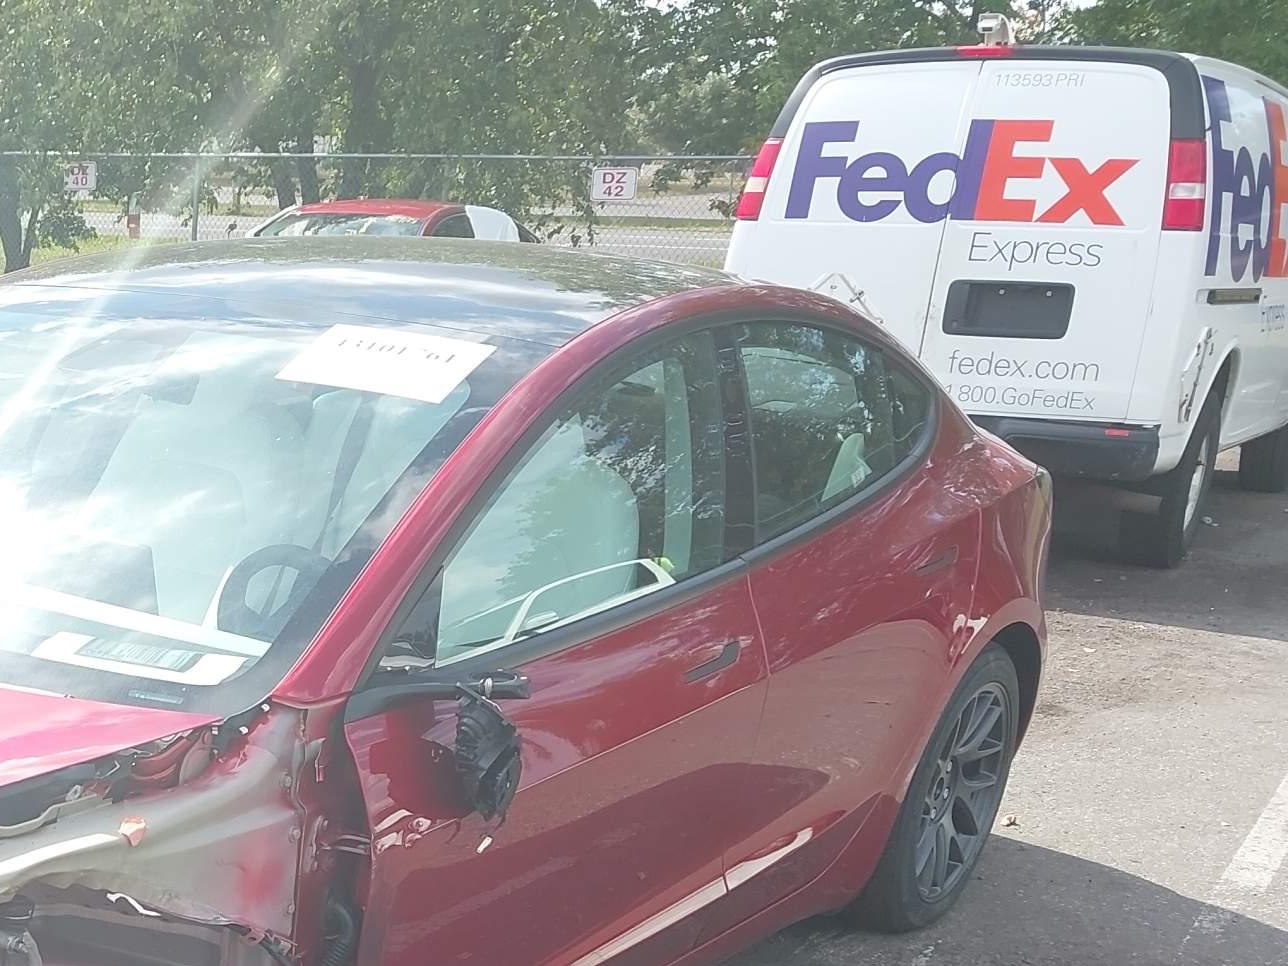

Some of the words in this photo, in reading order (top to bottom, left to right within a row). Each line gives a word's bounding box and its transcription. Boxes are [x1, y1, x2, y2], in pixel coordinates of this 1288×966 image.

[72, 175, 88, 186] 40
[602, 171, 628, 184] DZ
[785, 119, 1141, 226] FedEx
[1203, 74, 1288, 284] FedE
[602, 185, 625, 197] 42
[968, 231, 1104, 271] Express
[948, 349, 1100, 382] fedex.com
